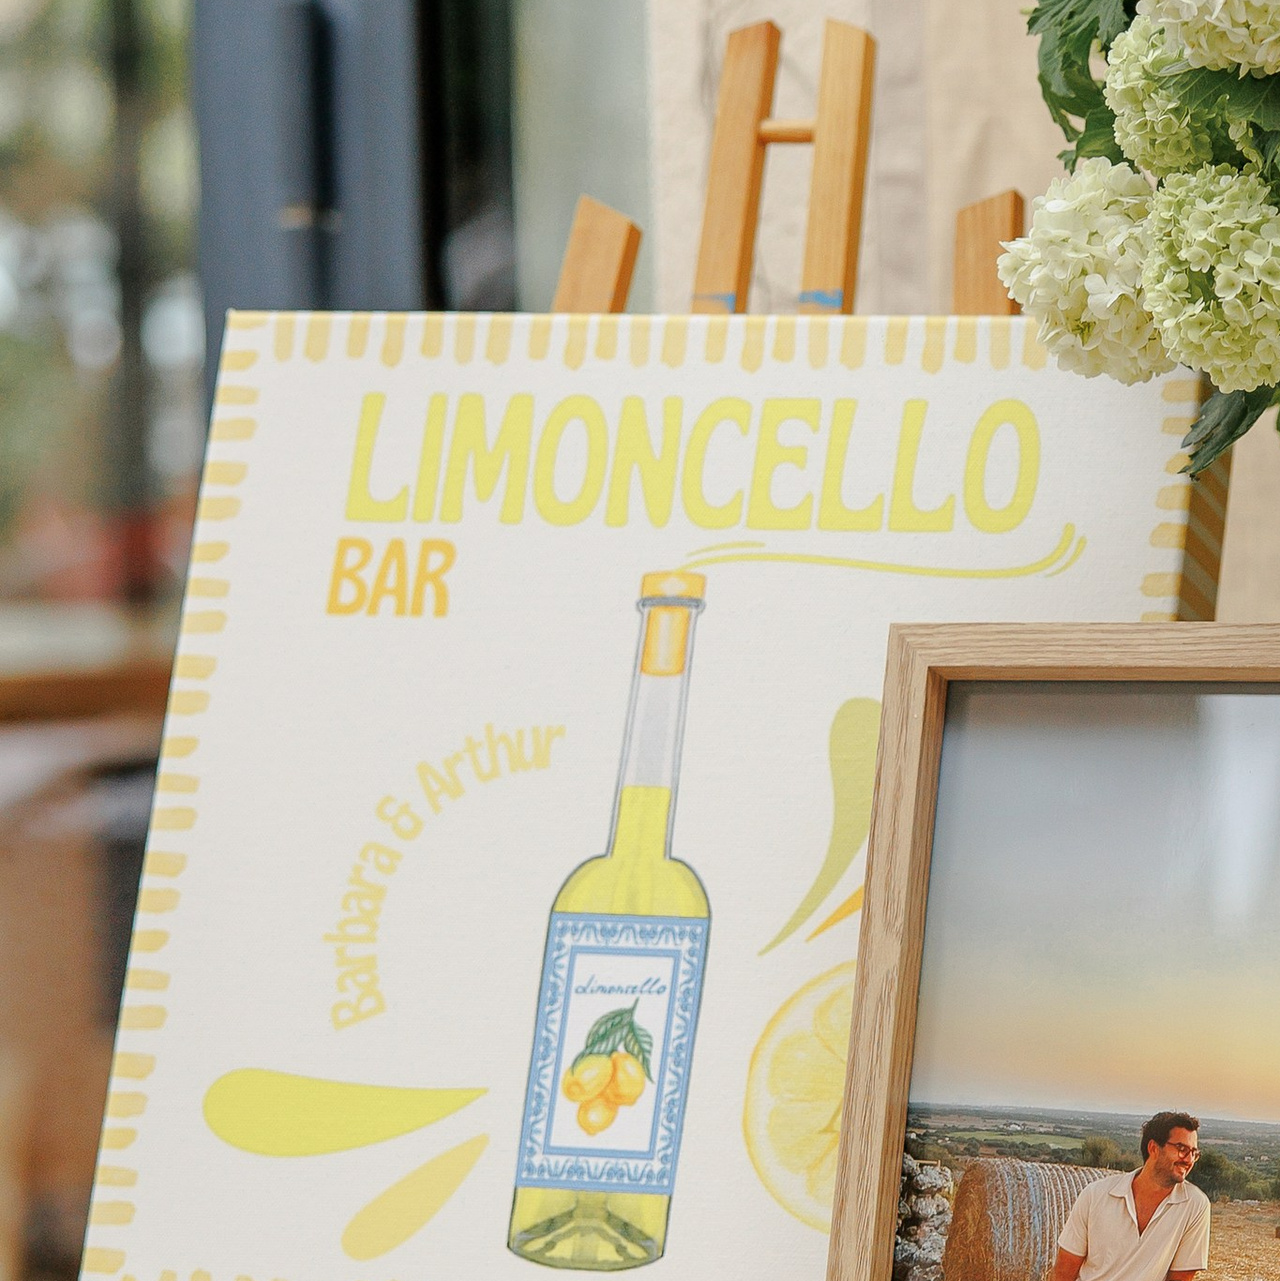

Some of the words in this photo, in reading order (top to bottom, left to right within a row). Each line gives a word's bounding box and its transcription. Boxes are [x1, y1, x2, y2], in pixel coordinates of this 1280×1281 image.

[344, 392, 1042, 535] LIMONCELLO
[325, 536, 458, 619] BAR
[323, 841, 403, 1031] Barbara
[375, 793, 424, 842] &
[415, 721, 567, 815] Arthur
